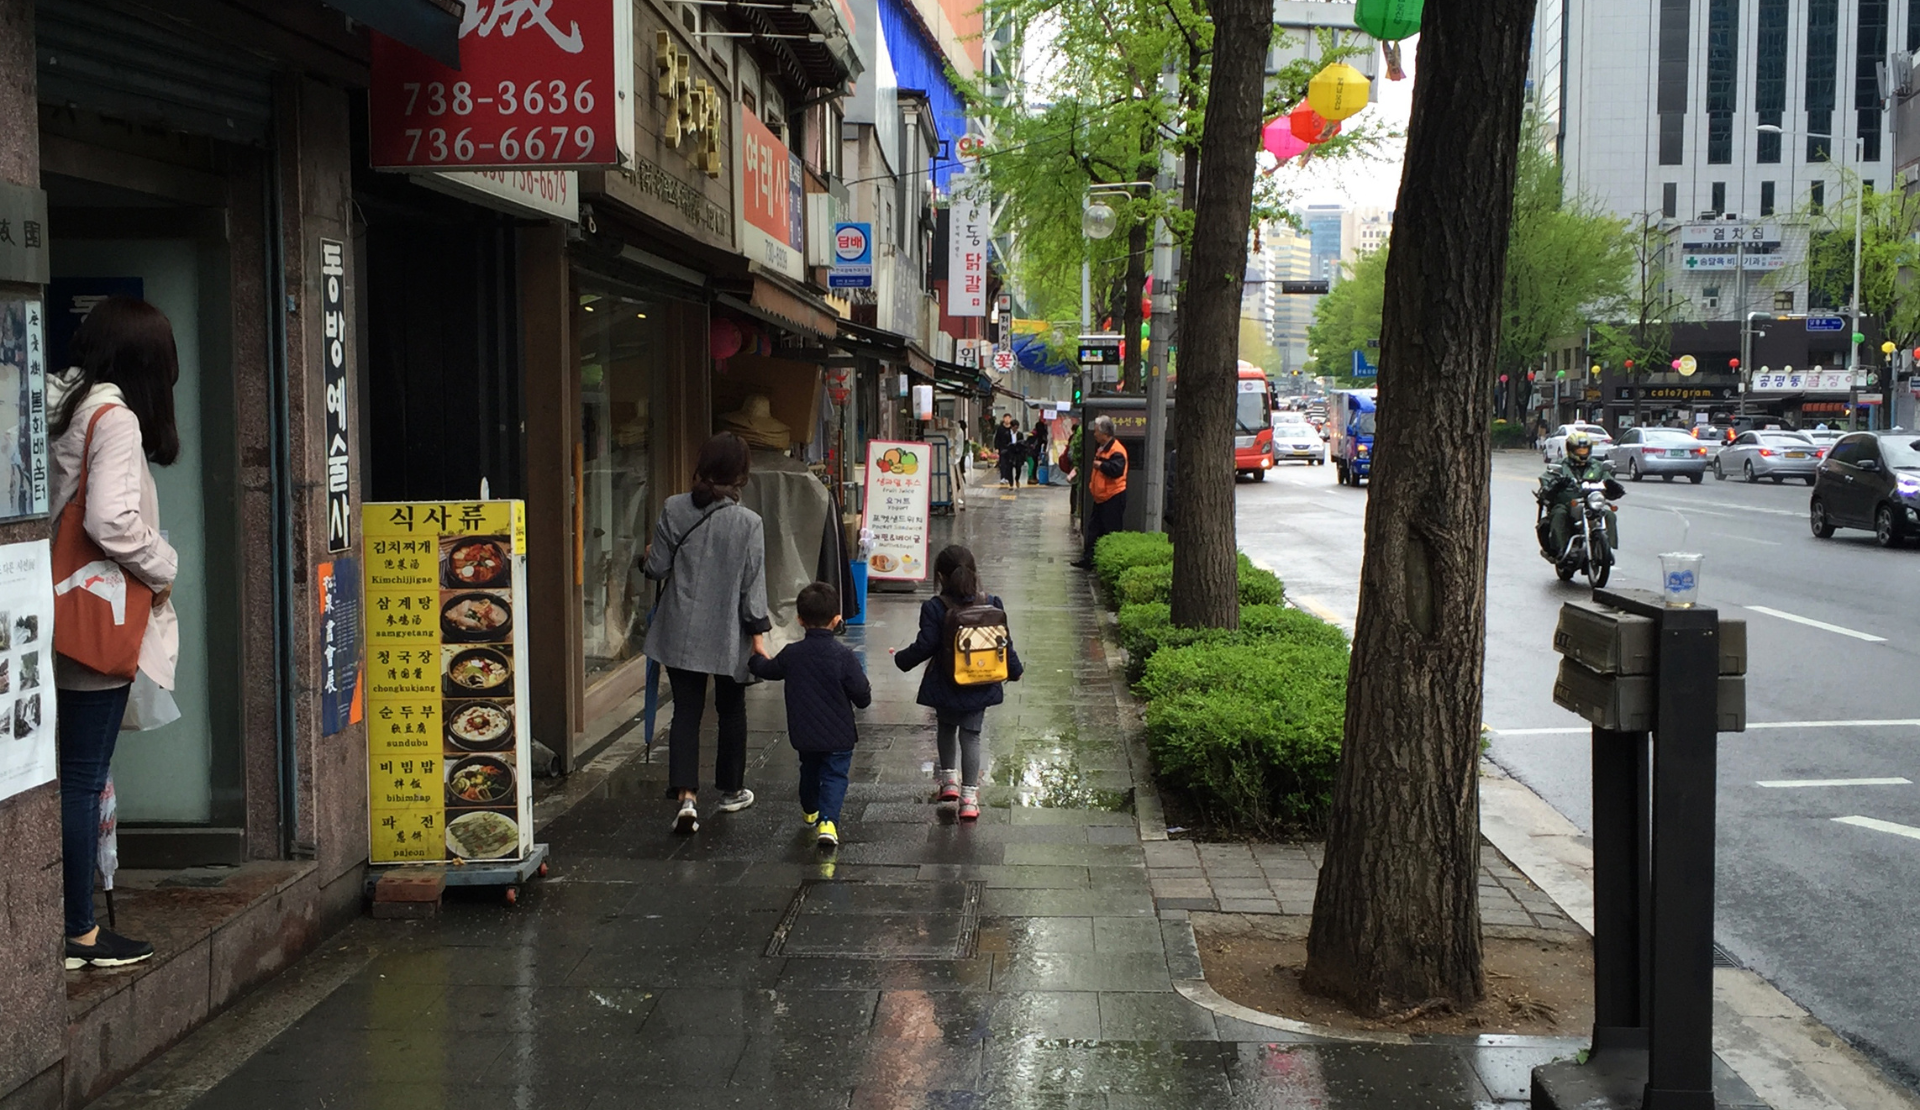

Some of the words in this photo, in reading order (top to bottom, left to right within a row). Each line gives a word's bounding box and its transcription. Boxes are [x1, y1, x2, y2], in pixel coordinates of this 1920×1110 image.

[404, 79, 595, 116] 738-3636
[405, 126, 595, 162] 736-6679
[745, 132, 787, 227] 여래사
[837, 235, 863, 249] 담배
[1727, 257, 1760, 266] 비기과
[965, 252, 982, 293] 닭칼
[995, 352, 1012, 369] 꽃
[1759, 375, 1801, 388] 공평동
[322, 244, 351, 548] 동방예술사
[876, 477, 902, 487] 생과일
[905, 478, 922, 487] 주스
[885, 496, 911, 505] 요거트
[389, 504, 486, 532] 식사류
[872, 514, 923, 523] 포켓샌드위치
[373, 540, 431, 554] 김치찌개
[371, 576, 432, 585] Kimchijjigae
[376, 596, 433, 610] 삼계탕
[375, 630, 434, 638] samgyetang
[377, 650, 432, 664] 청국장
[373, 684, 435, 693] chongkukjang
[379, 705, 435, 719] 순두부
[386, 739, 428, 747] sundubu
[380, 760, 435, 774] 비빔밥
[386, 794, 431, 803] bibimbap
